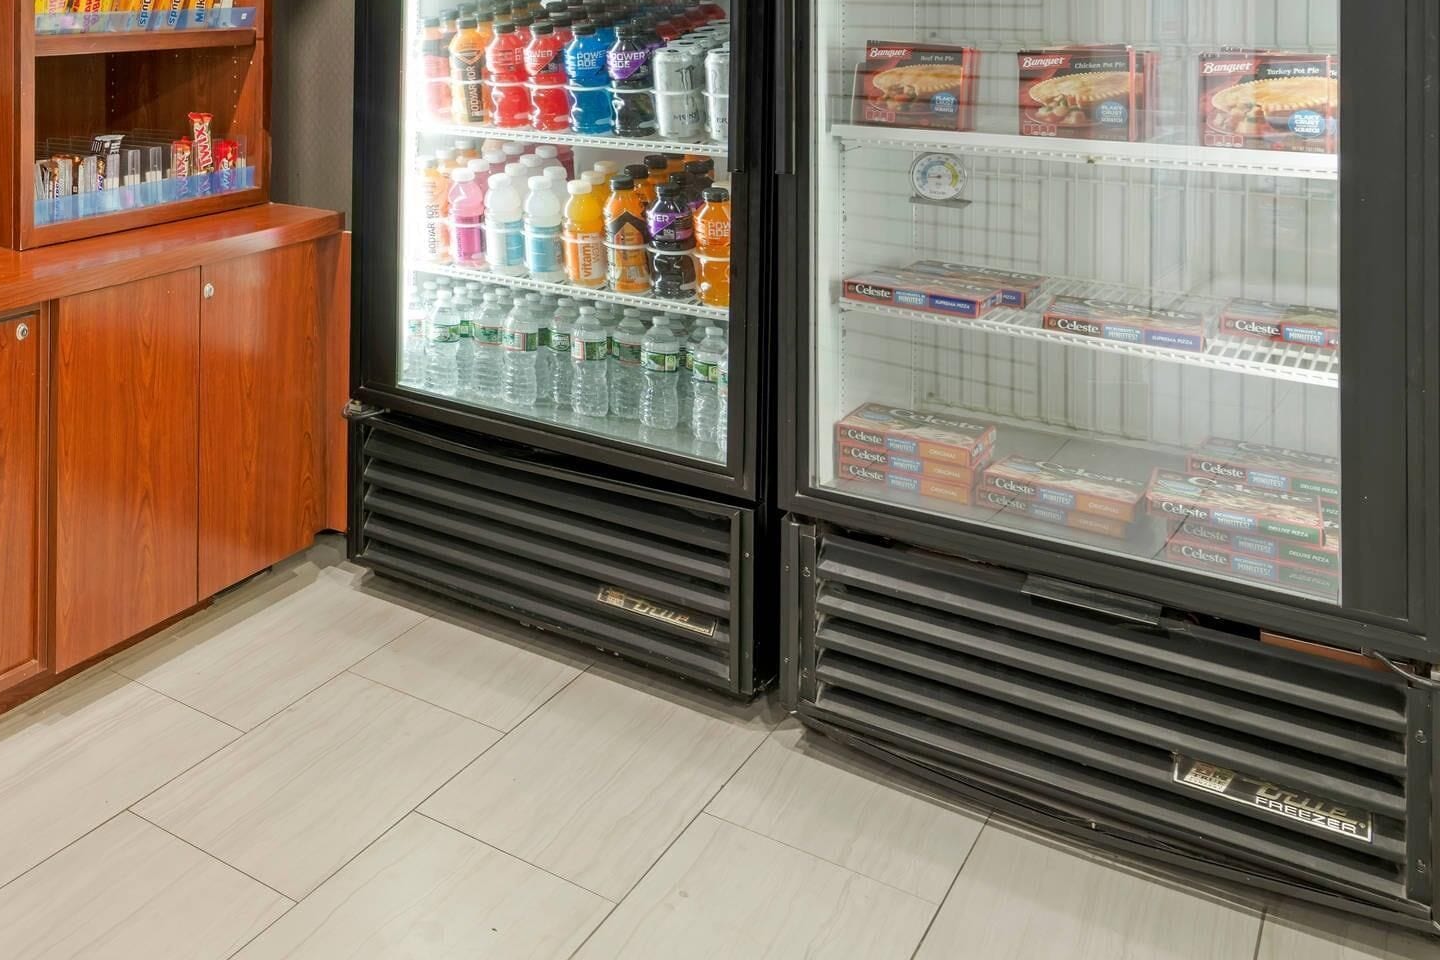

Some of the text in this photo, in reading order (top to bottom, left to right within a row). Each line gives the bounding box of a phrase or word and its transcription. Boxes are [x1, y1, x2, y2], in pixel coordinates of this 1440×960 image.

[610, 51, 646, 61] POWER
[870, 48, 908, 58] Banquet
[1023, 57, 1065, 68] Banquet
[1203, 63, 1253, 73] Banquet
[1266, 68, 1291, 76] Turkey
[194, 125, 214, 169] TWIX
[855, 284, 892, 299] Celeste
[957, 302, 970, 310] PIZZA
[1057, 319, 1100, 335] Celeste
[1234, 320, 1280, 336] Celeste
[1289, 332, 1321, 343] MINUTES!
[848, 429, 882, 443] Celeste
[851, 449, 887, 463] Celeste
[849, 466, 883, 480] Celeste
[1201, 461, 1245, 478] Celeste
[995, 478, 1034, 495] Celeste
[1300, 483, 1338, 495] DELUXE PIZZA
[988, 493, 1026, 510] Celeste
[1162, 501, 1208, 519] Celeste
[1183, 523, 1228, 542] Celeste
[1268, 525, 1309, 537] DELUXE PIZZA
[1182, 545, 1227, 564] Celeste
[1288, 550, 1329, 563] DELUXE PIZZA
[1255, 795, 1358, 834] FREEZER
